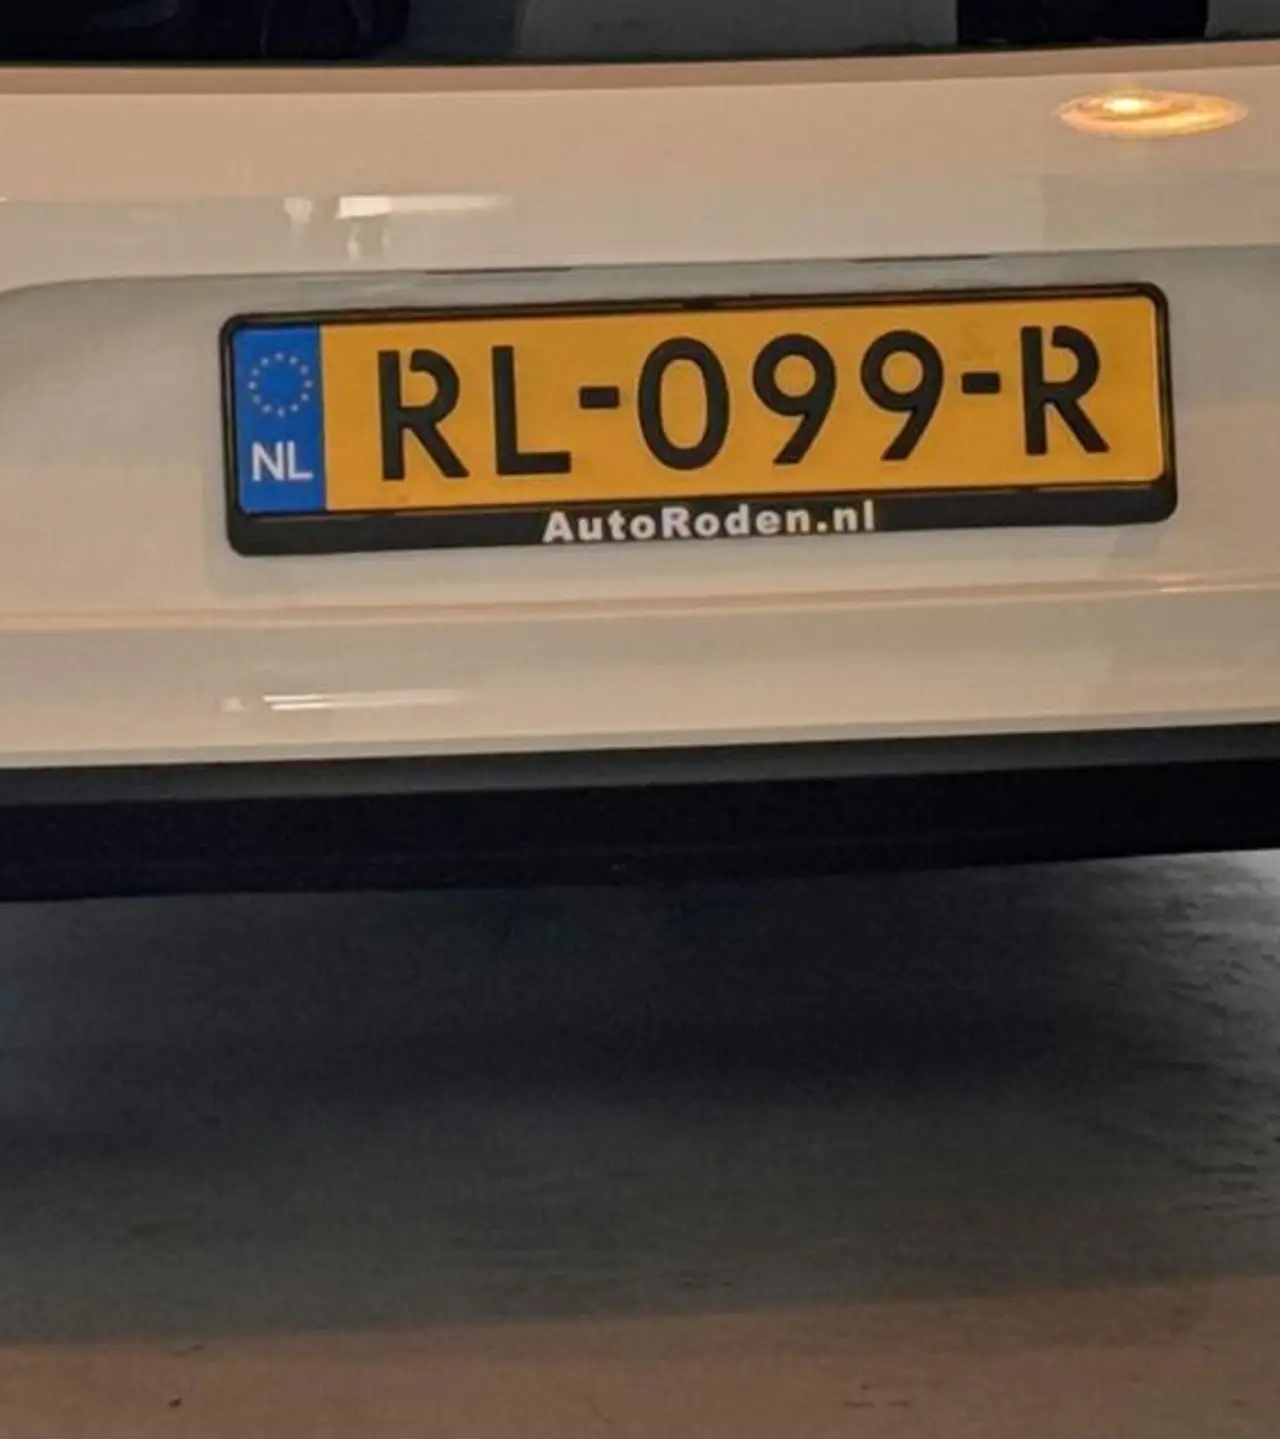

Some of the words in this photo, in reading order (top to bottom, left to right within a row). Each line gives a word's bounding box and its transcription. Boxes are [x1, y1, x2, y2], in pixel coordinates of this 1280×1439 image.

[376, 326, 1111, 482] RL-099-R
[252, 441, 313, 480] NL
[542, 500, 874, 542] AutoRoden.nl
